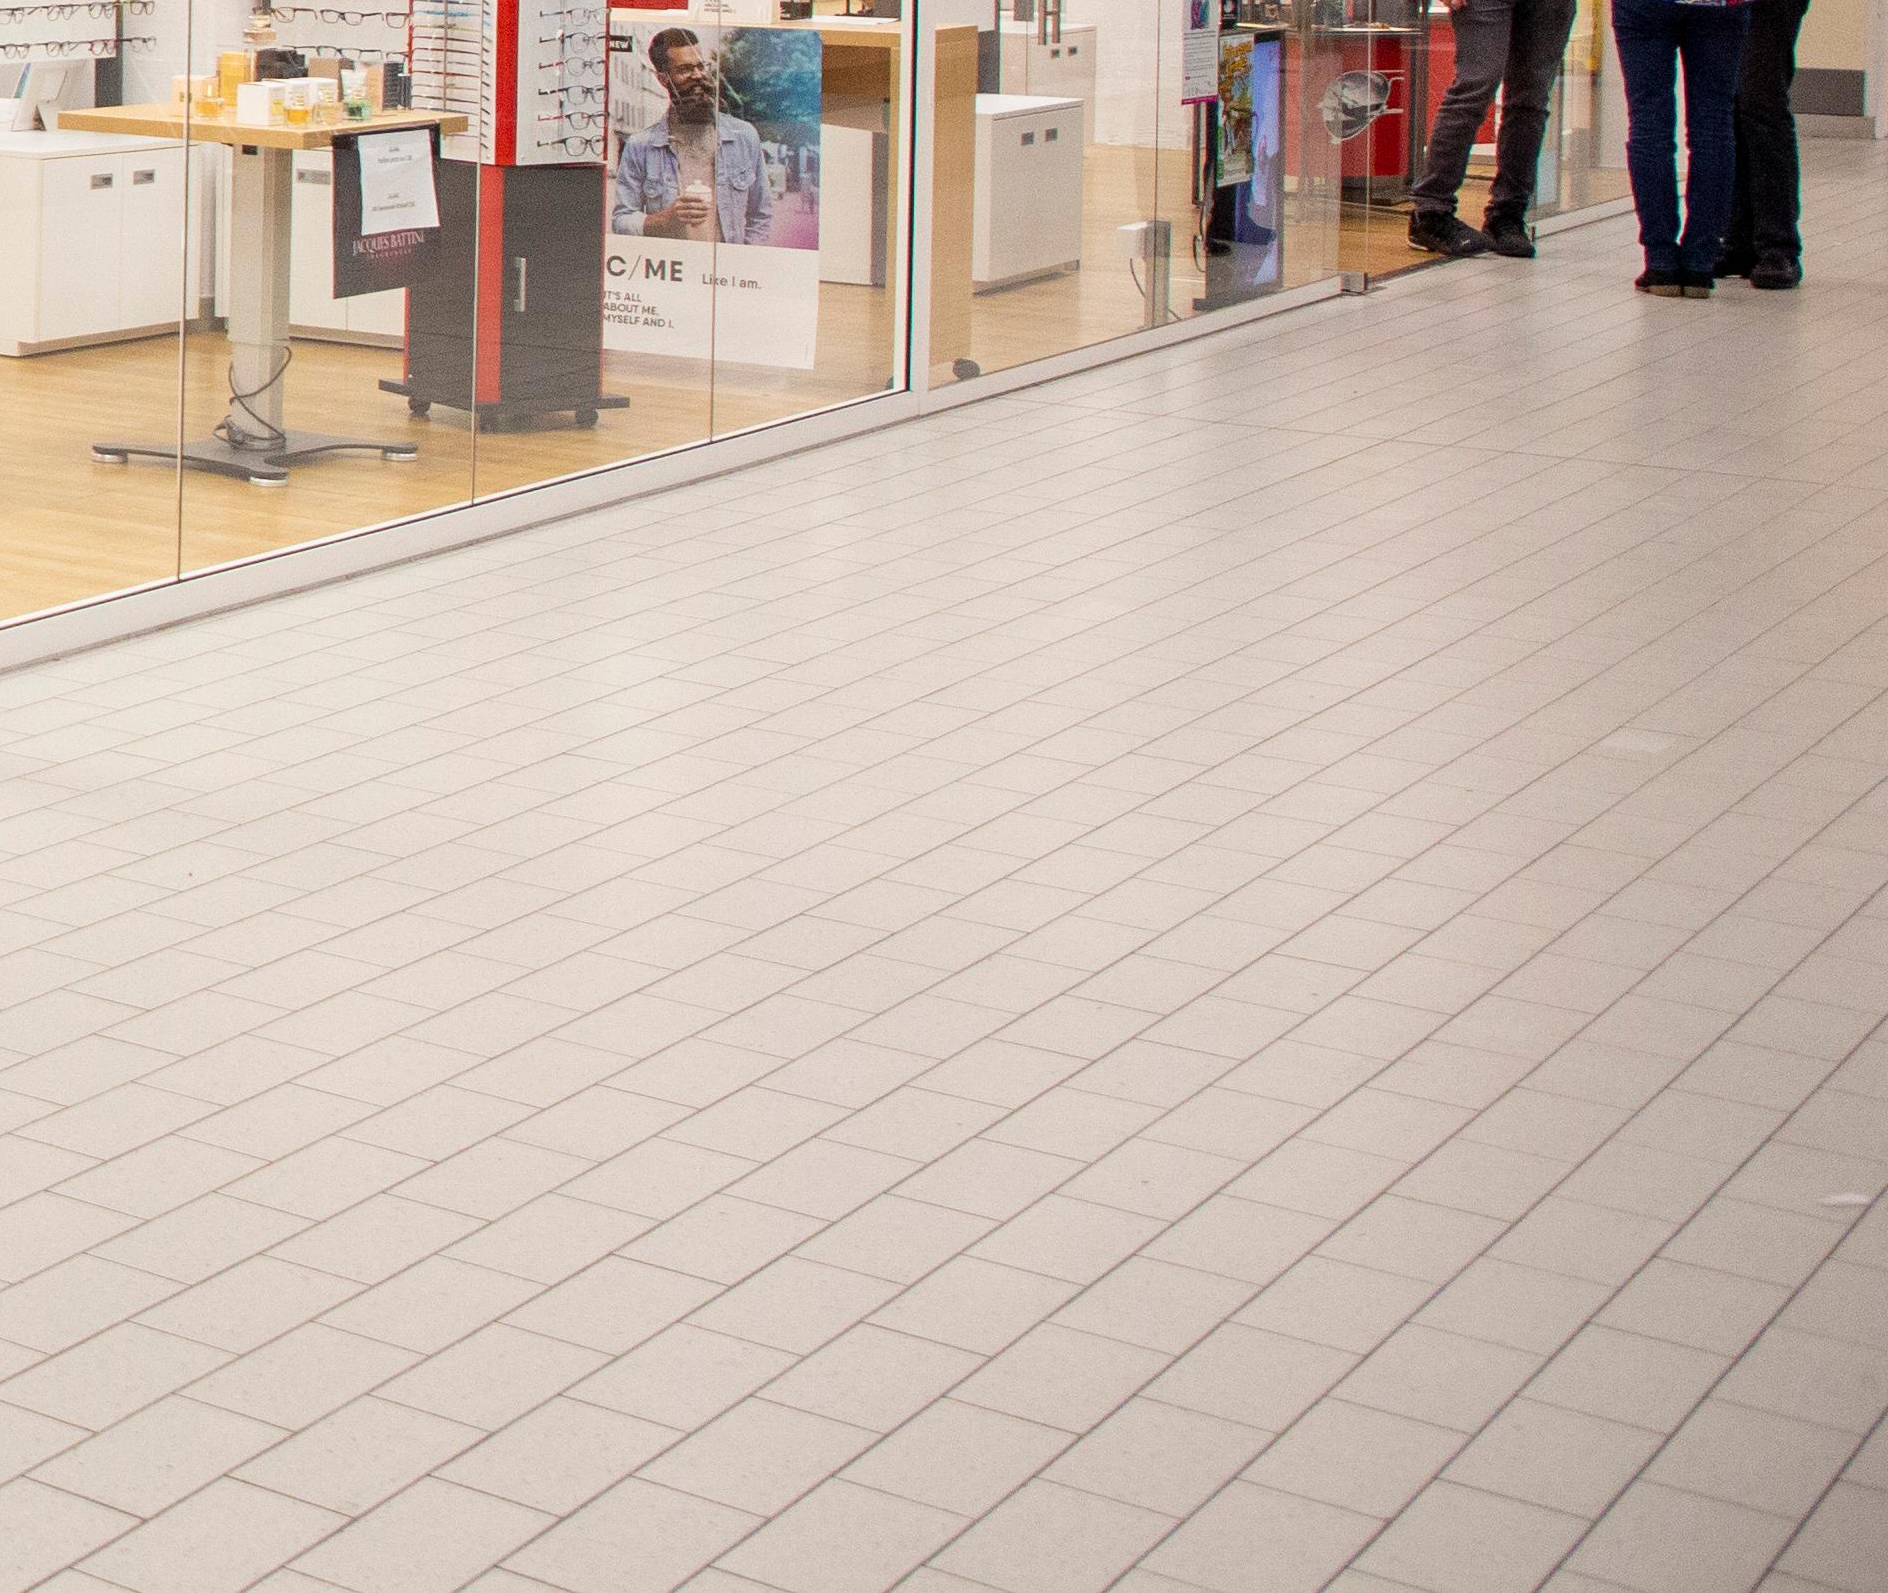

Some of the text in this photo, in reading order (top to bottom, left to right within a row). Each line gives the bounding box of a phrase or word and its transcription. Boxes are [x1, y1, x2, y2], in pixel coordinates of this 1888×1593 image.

[606, 255, 683, 283] C/ME
[702, 273, 727, 287] Like
[739, 278, 762, 289] am.
[624, 293, 642, 303] ALL
[603, 302, 639, 313] ABOUT
[603, 314, 640, 325] MYSELF
[643, 317, 665, 327] AND
